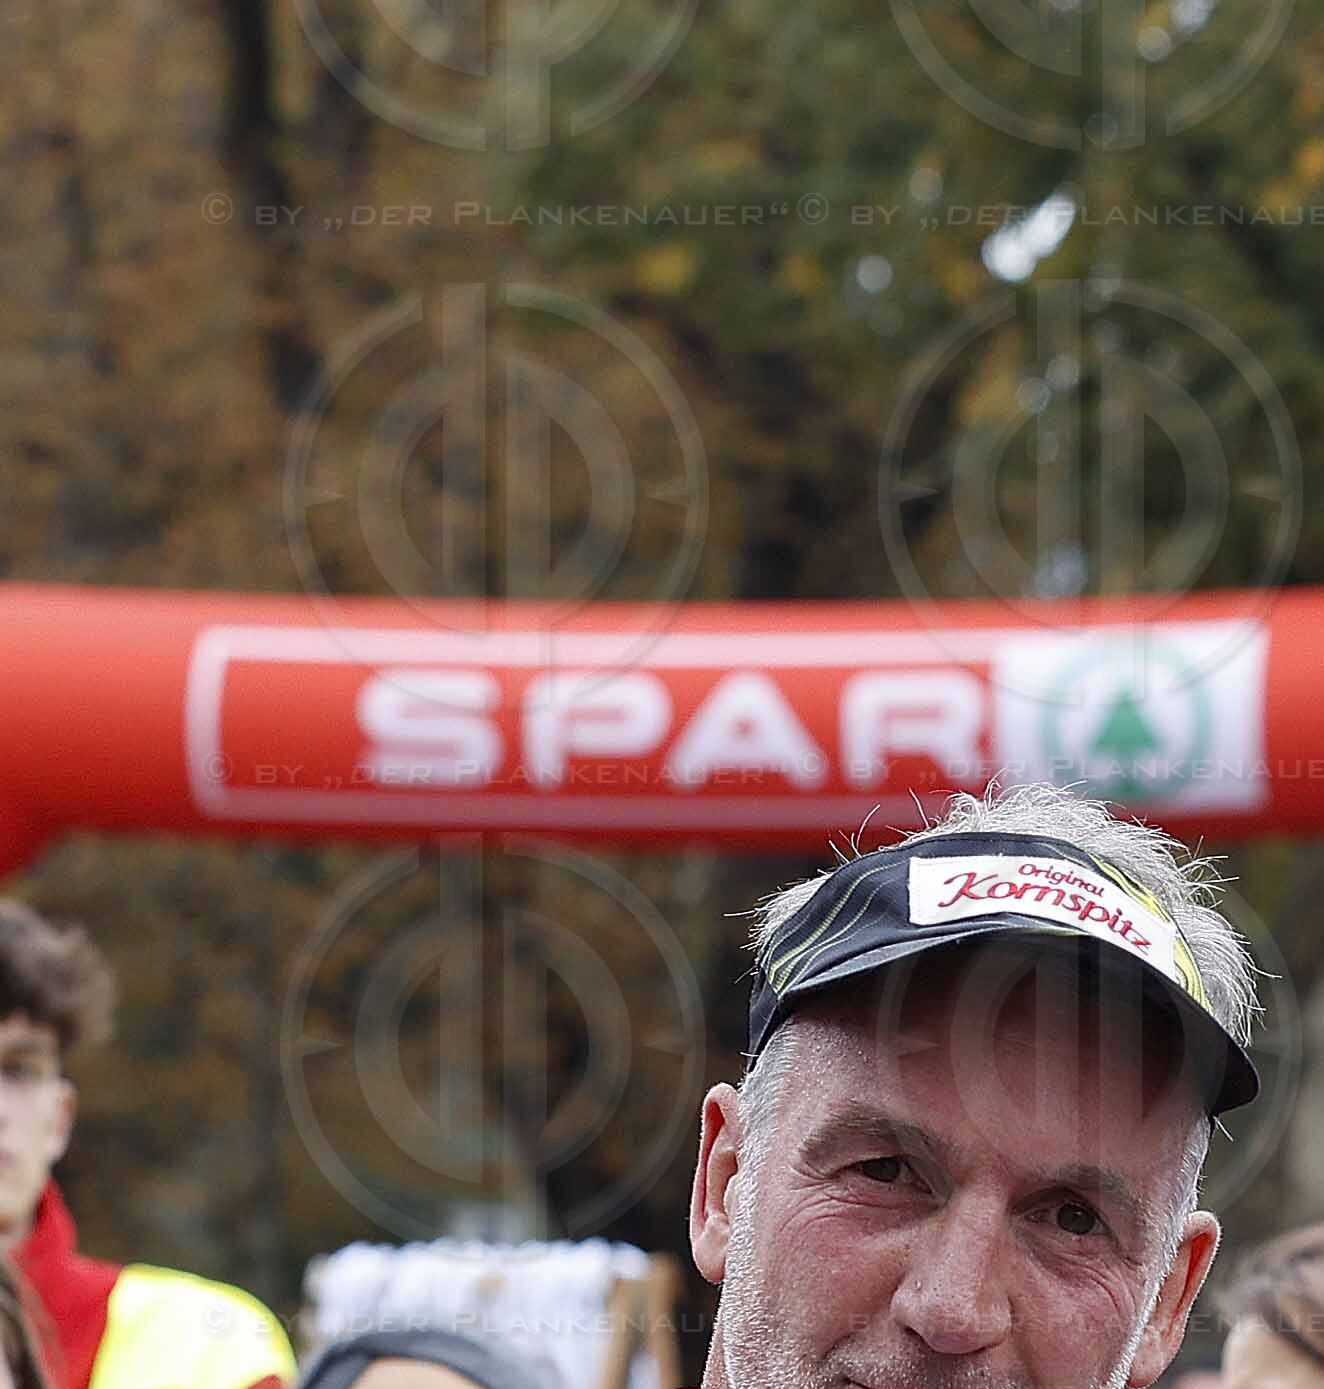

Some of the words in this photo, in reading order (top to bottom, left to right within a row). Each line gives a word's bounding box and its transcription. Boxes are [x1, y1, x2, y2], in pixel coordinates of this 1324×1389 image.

[355, 666, 990, 791] SPAR
[937, 870, 1153, 953] Kornspitz
[1018, 862, 1105, 898] Original
